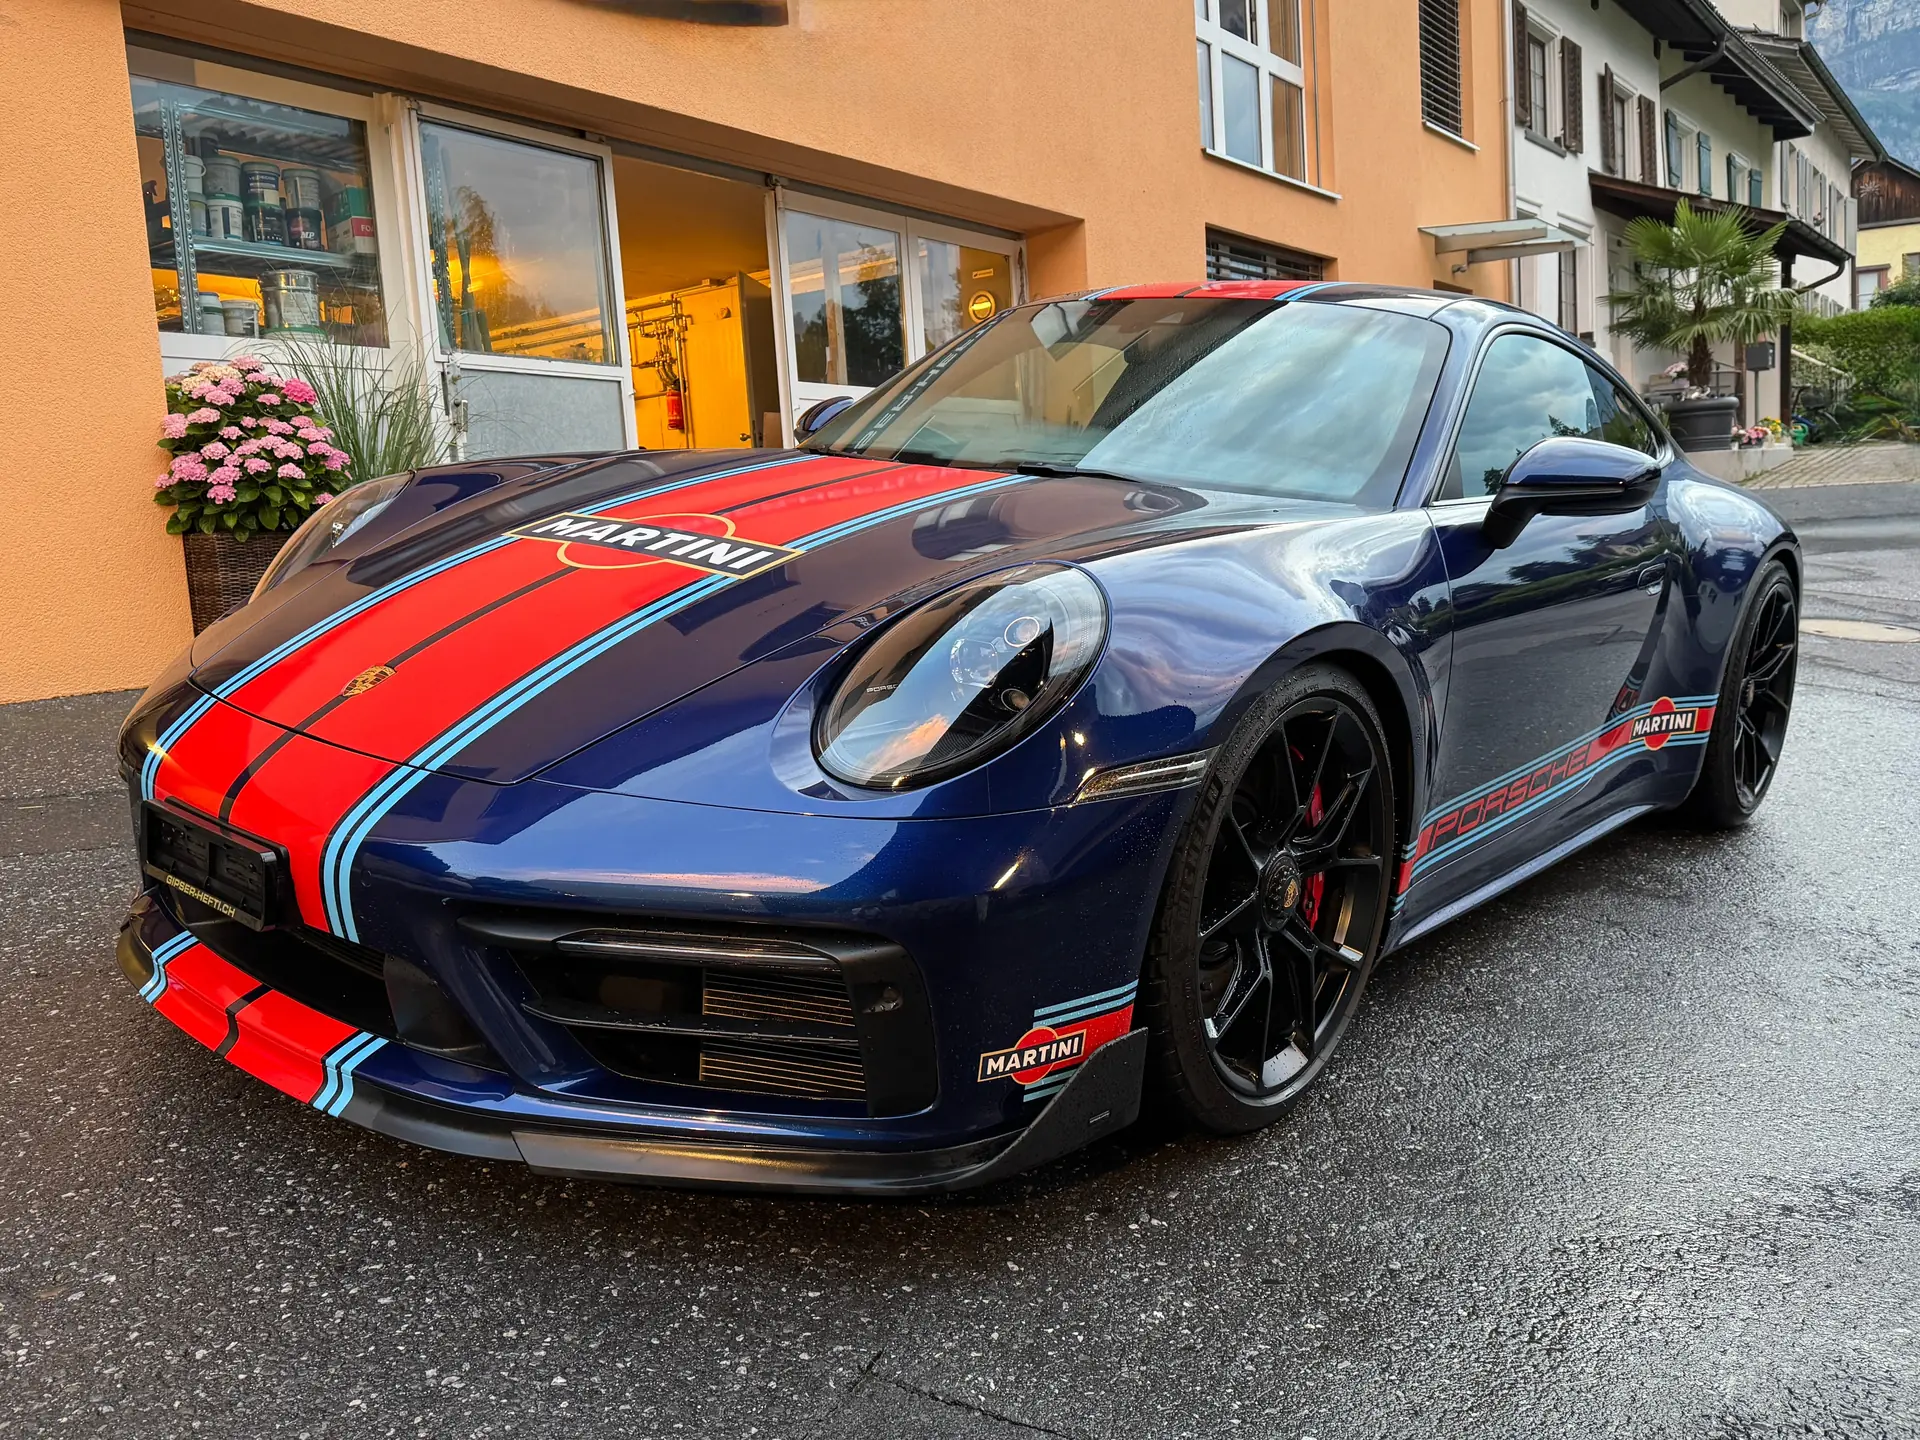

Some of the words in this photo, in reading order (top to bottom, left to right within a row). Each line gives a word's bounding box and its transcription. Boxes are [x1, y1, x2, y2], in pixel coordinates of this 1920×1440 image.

[532, 517, 775, 570] MARTINI
[1632, 712, 1694, 737] MARTINI
[1430, 743, 1591, 849] PORSCHE
[166, 874, 236, 918] GIPSER-HEFTI.CH
[986, 1036, 1079, 1076] MARTINI
